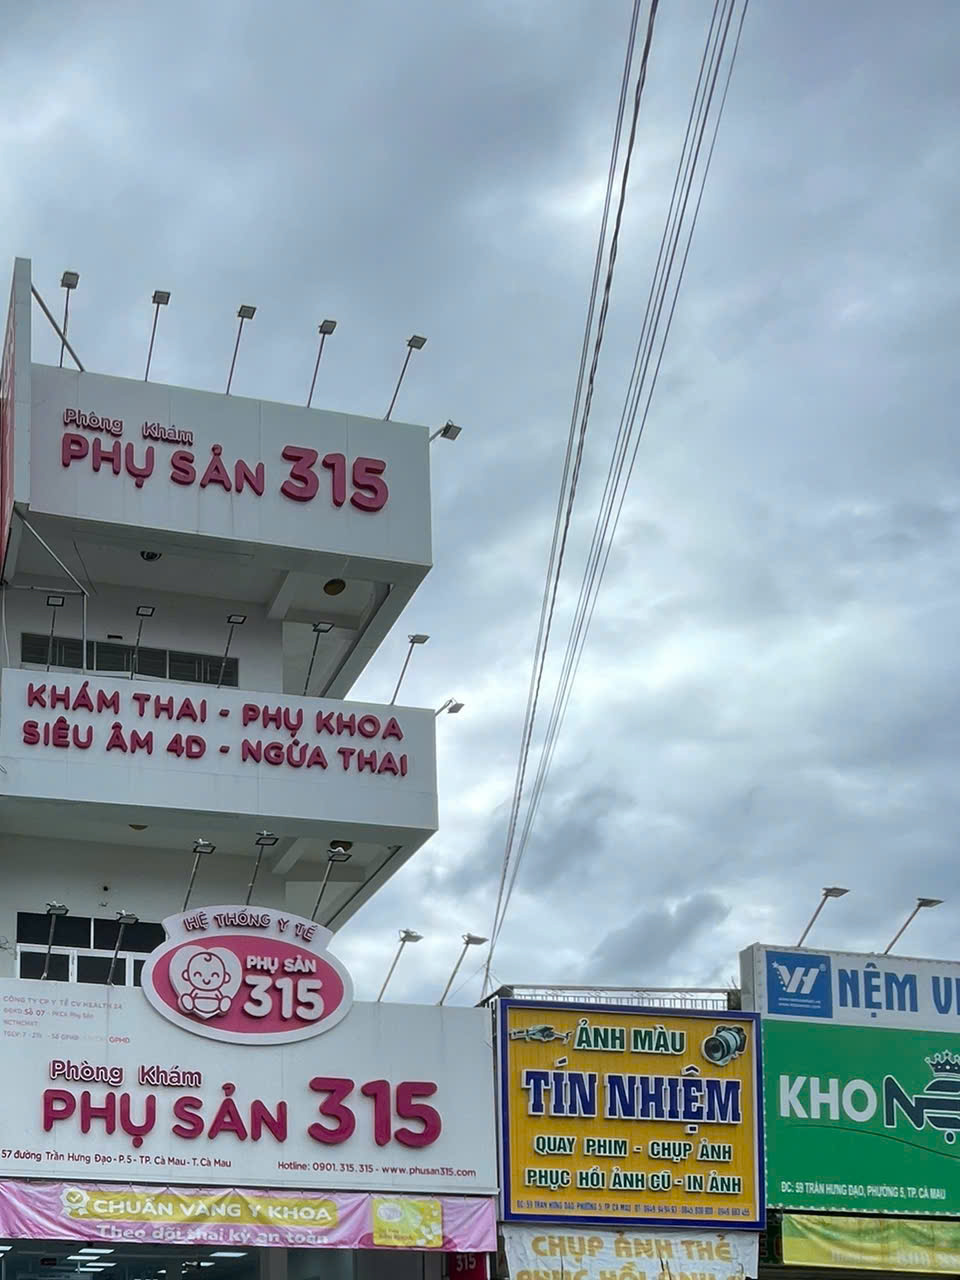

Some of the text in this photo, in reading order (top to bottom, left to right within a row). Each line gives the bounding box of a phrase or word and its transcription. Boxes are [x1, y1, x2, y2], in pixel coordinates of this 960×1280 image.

[141, 421, 194, 445] Khám
[61, 433, 389, 513] PHỤ SẢN 315
[26, 681, 404, 741] KHÁM THAI PHỤ KHOA
[22, 715, 93, 749] SIÊU
[105, 721, 153, 755] ÂM
[166, 733, 206, 759] 4D
[337, 747, 408, 777] THAI
[183, 909, 318, 942] HỆ THỐNG Y TẾ
[246, 954, 317, 974] PHỤ SẢN
[243, 974, 325, 1022] 315
[838, 962, 918, 1018] NỆM
[574, 1018, 687, 1054] ẢNH MÀU
[49, 1059, 202, 1088] Phòng Khám
[521, 1056, 742, 1134] TÍN NHIỆM
[779, 1074, 878, 1123] KHO
[42, 1077, 442, 1149] PHỤ SẢN 315
[1, 1149, 232, 1168] 57 đường Trần Hưng TP. Cà Mau Cà Mau
[535, 1135, 733, 1162] QUAY PHIM CHỤP ẢNH
[277, 1161, 476, 1177] Hotline: www.phusan315.com
[525, 1165, 742, 1194] PHỤC HỒI ẢNH CŨ IN ẢNH
[93, 1198, 172, 1217] CHUẨN
[179, 1199, 241, 1217] VÀNG
[268, 1204, 332, 1221] KHOA
[95, 1224, 146, 1239] Theo
[531, 1231, 733, 1263] CHỤP ẢNH THẺ
[456, 1254, 476, 1271] 315
